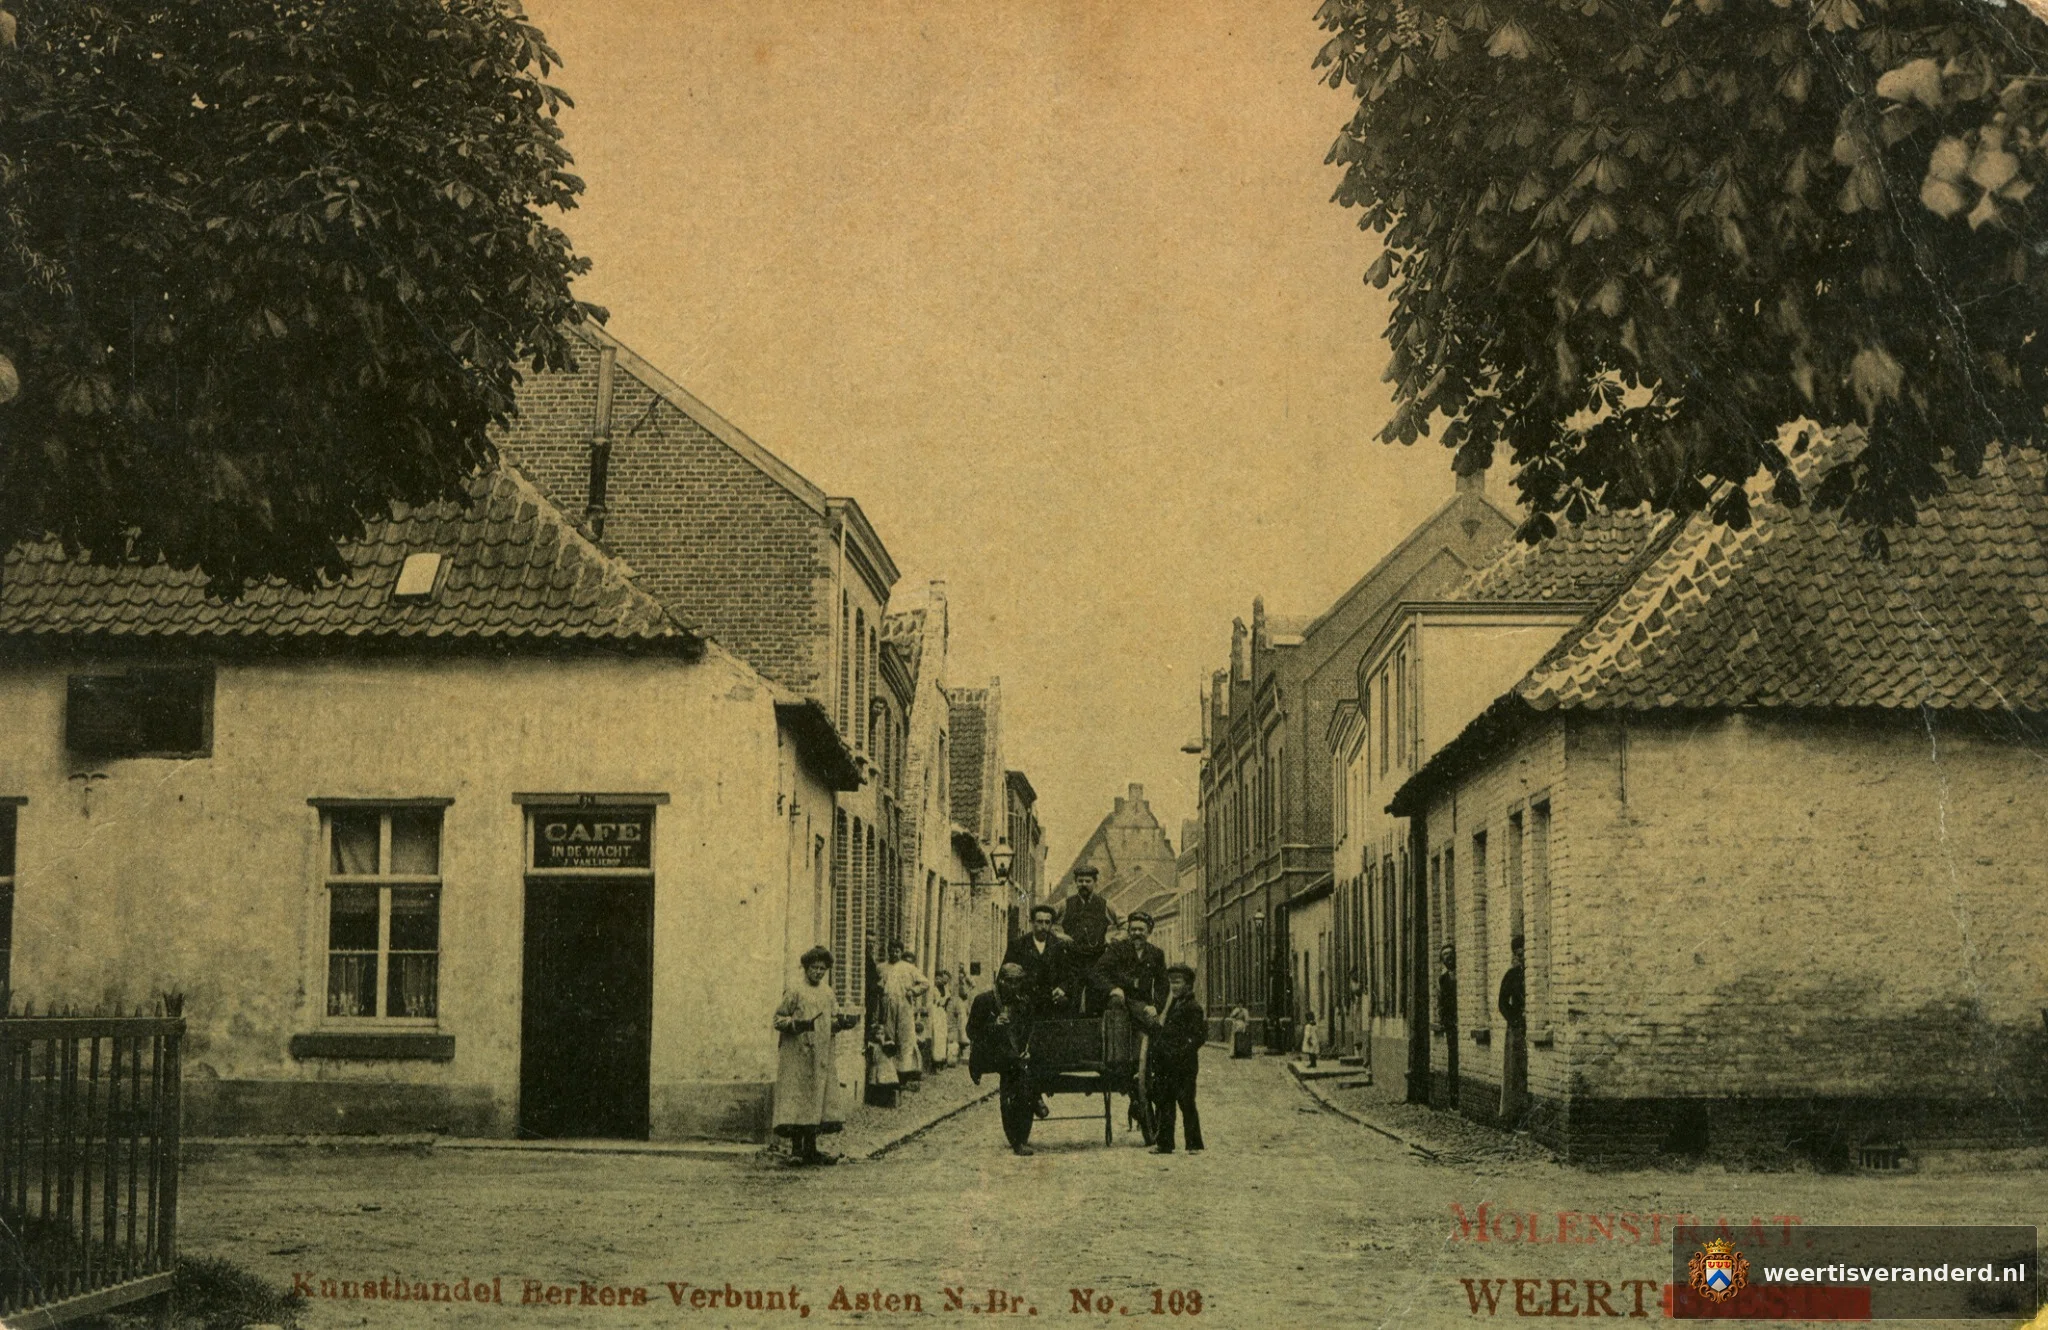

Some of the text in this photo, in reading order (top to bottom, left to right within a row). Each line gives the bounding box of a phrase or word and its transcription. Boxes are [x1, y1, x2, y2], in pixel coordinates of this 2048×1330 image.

[544, 822, 641, 842] CAFE
[552, 845, 632, 857] IN DE WACHT
